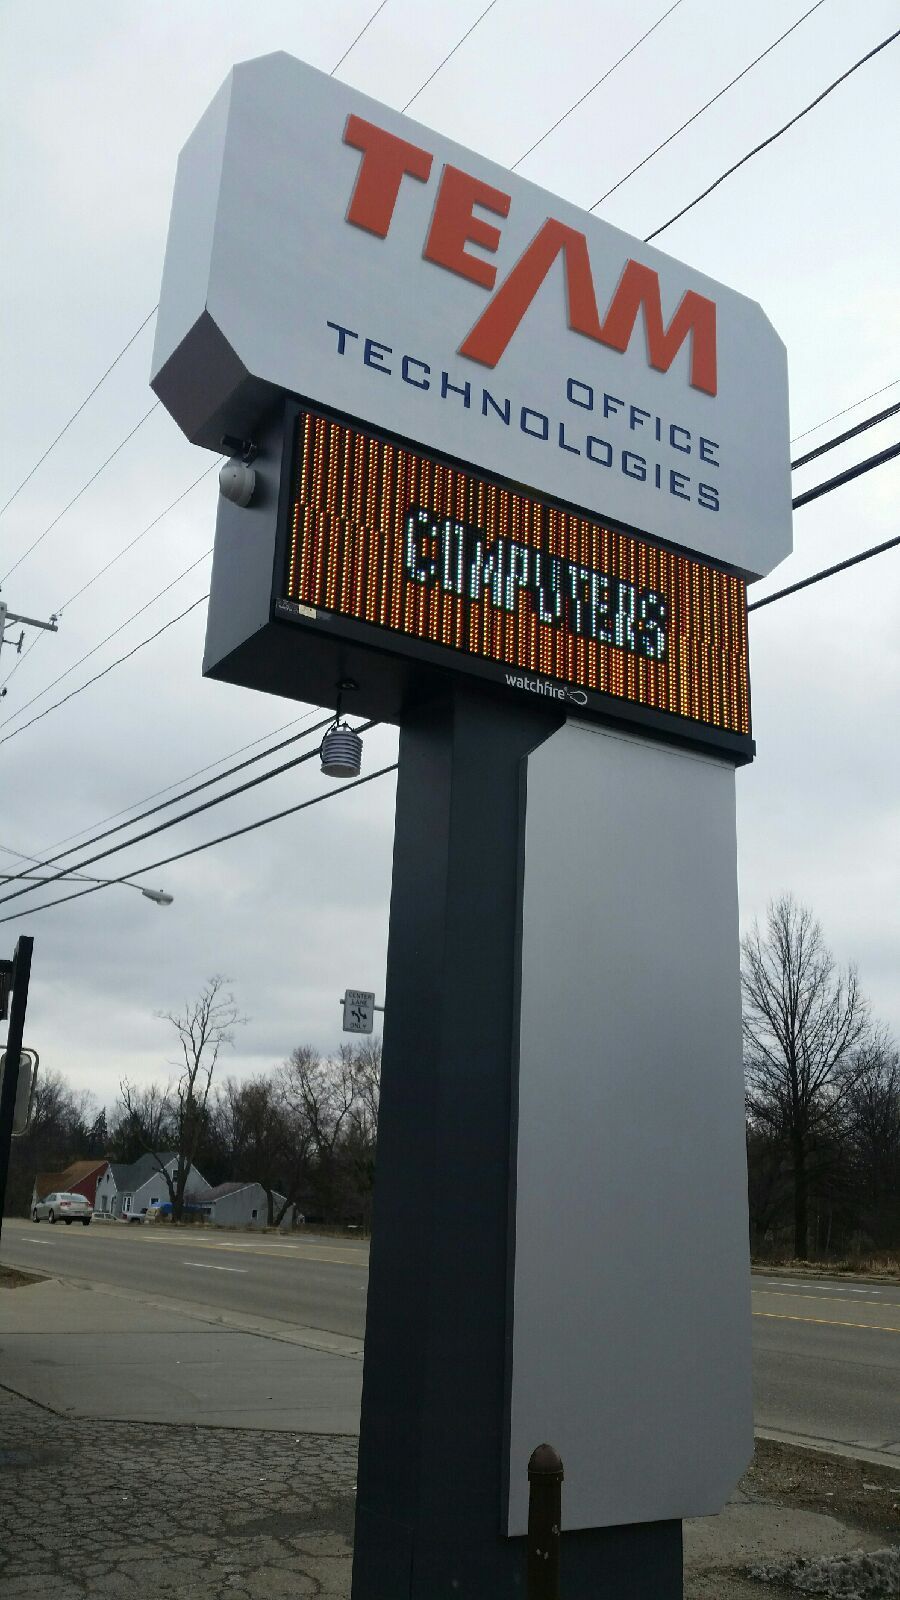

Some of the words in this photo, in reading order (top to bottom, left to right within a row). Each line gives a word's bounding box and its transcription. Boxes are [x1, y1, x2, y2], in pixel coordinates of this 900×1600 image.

[343, 113, 717, 398] TEAM
[327, 320, 720, 512] TECHNOLOGIES
[567, 377, 720, 467] OFFICE
[406, 509, 666, 661] COMPUTERS
[348, 992, 372, 1000] CENTER
